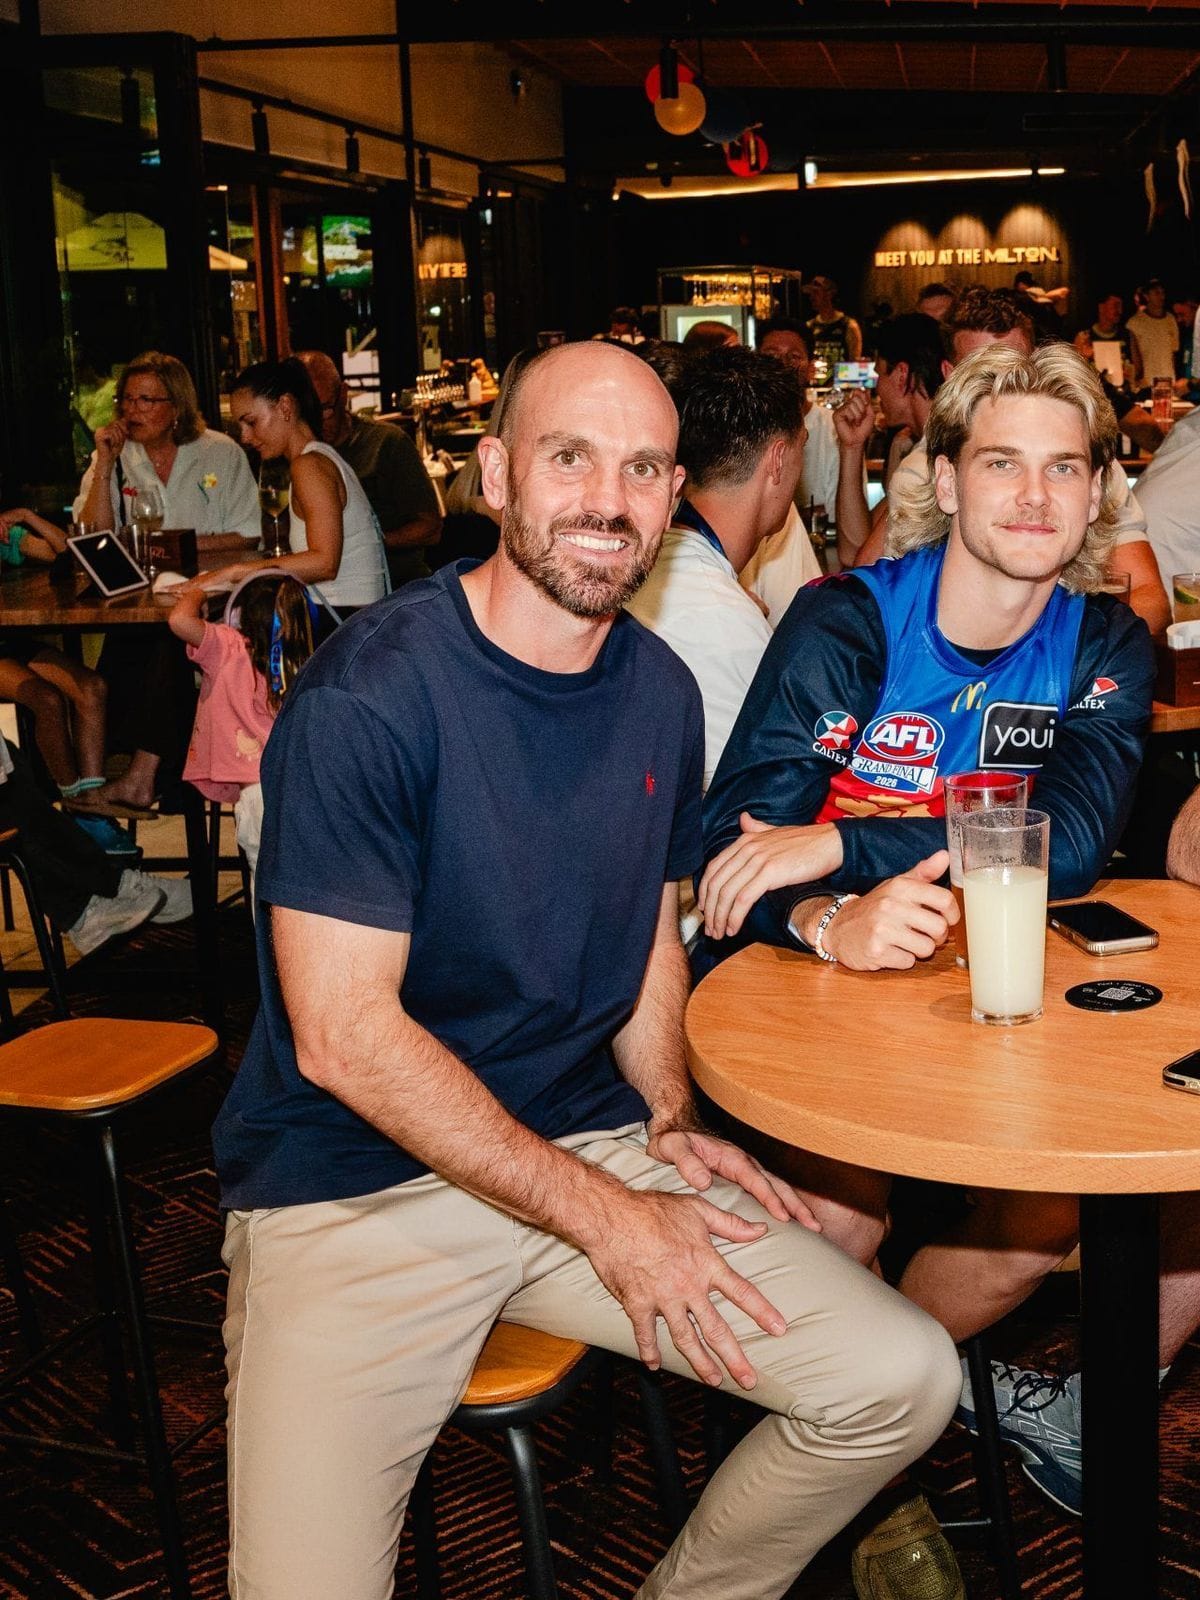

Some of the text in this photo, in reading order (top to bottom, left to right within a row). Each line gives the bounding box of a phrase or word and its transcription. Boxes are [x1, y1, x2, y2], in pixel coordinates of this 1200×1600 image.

[875, 251, 907, 267] MEET
[909, 250, 936, 266] YOU
[938, 249, 954, 265] AT
[956, 248, 981, 265] THE
[867, 722, 936, 752] AFL
[993, 718, 1056, 756] youi
[812, 741, 848, 767] CALTEX
[852, 757, 932, 789] GRAND FINAL
[874, 775, 898, 788] 2026
